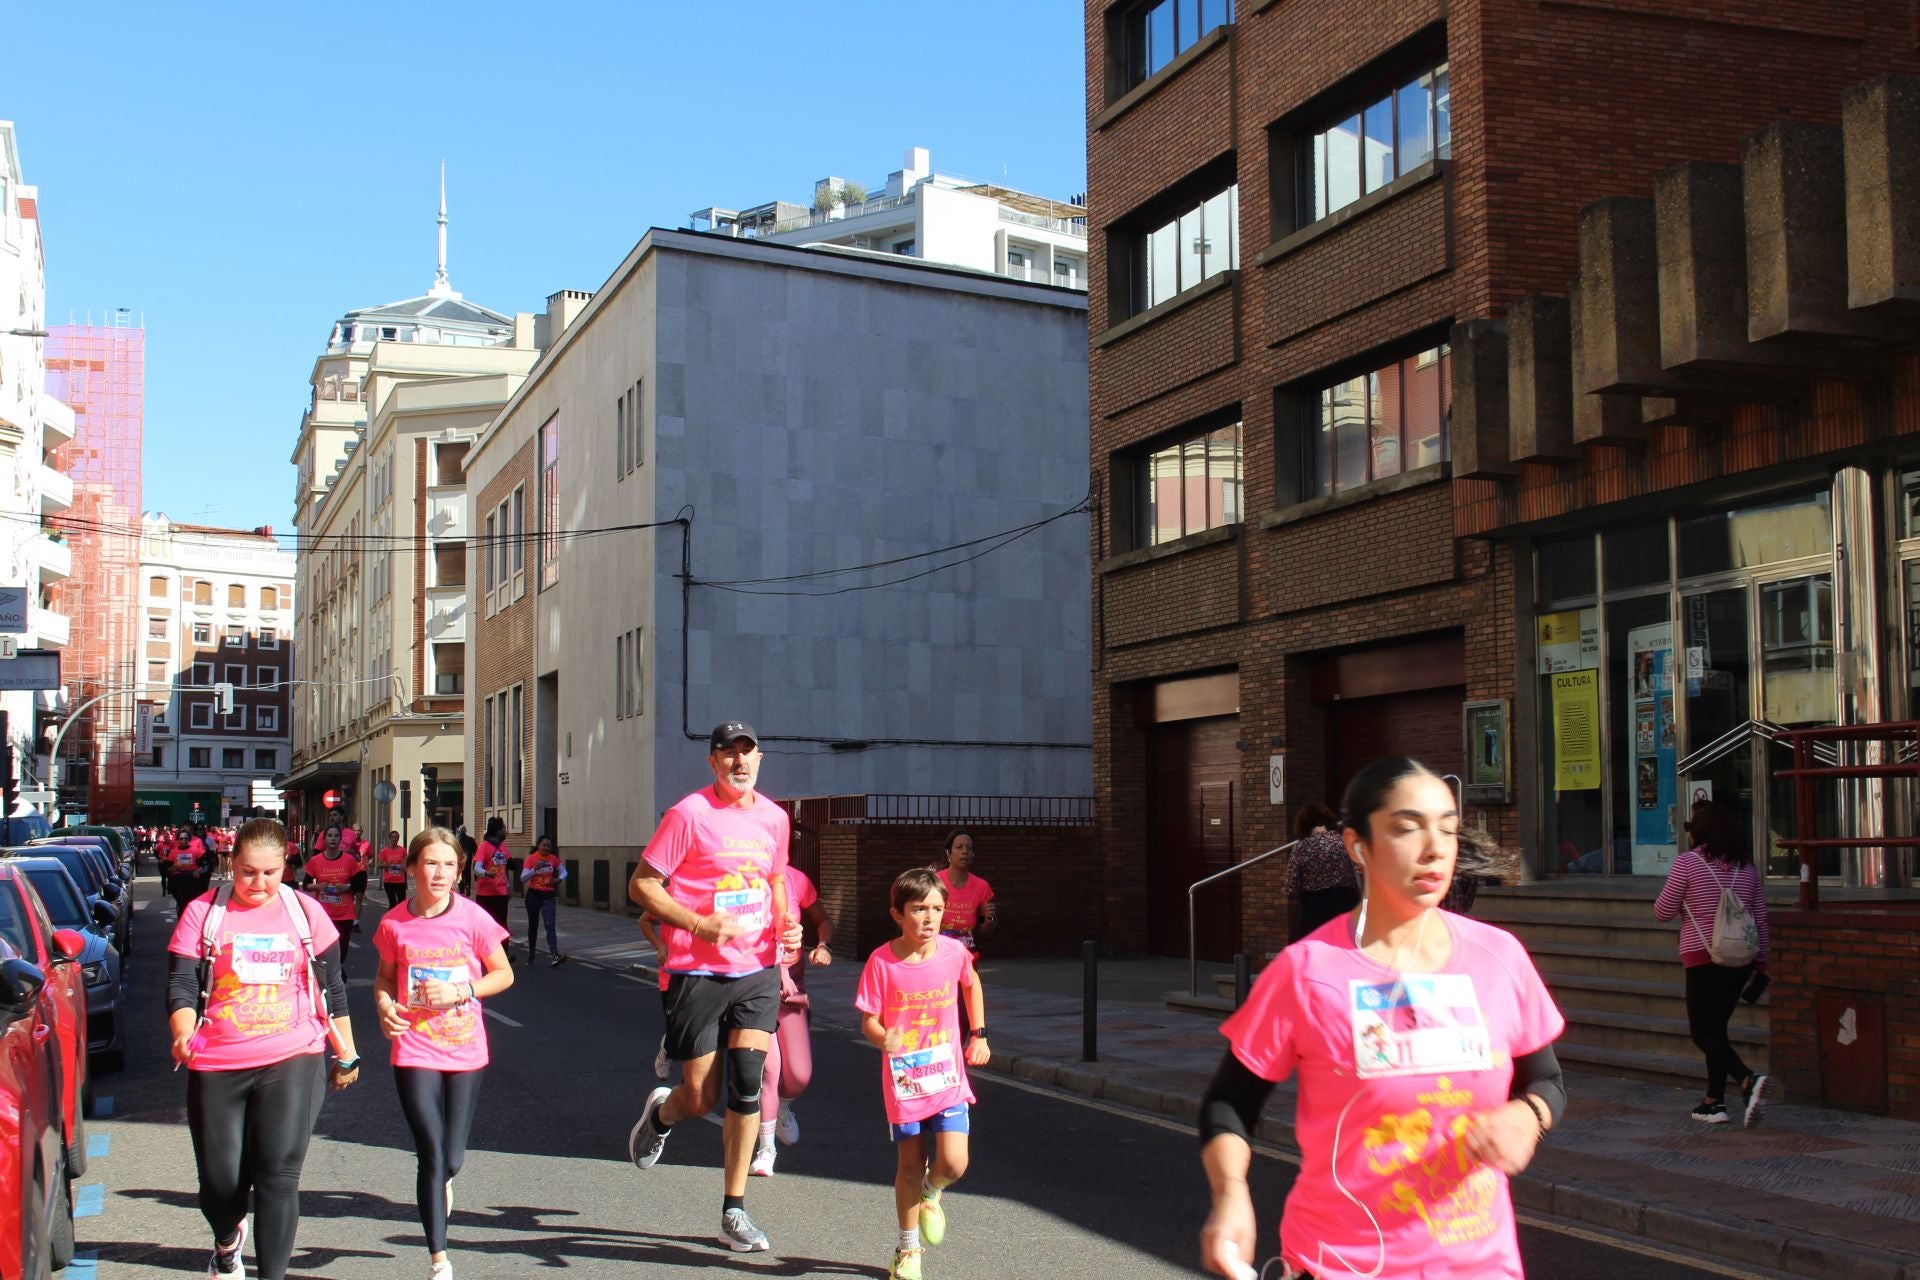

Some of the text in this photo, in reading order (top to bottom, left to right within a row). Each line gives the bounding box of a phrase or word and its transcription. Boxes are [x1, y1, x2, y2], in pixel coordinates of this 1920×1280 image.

[1557, 675, 1591, 687] CULTURA
[252, 951, 285, 963] 0927
[894, 981, 951, 1003] Drasanvi
[239, 1001, 293, 1016] Carrera
[253, 1011, 293, 1025] Mujer
[915, 1062, 944, 1079] 3780
